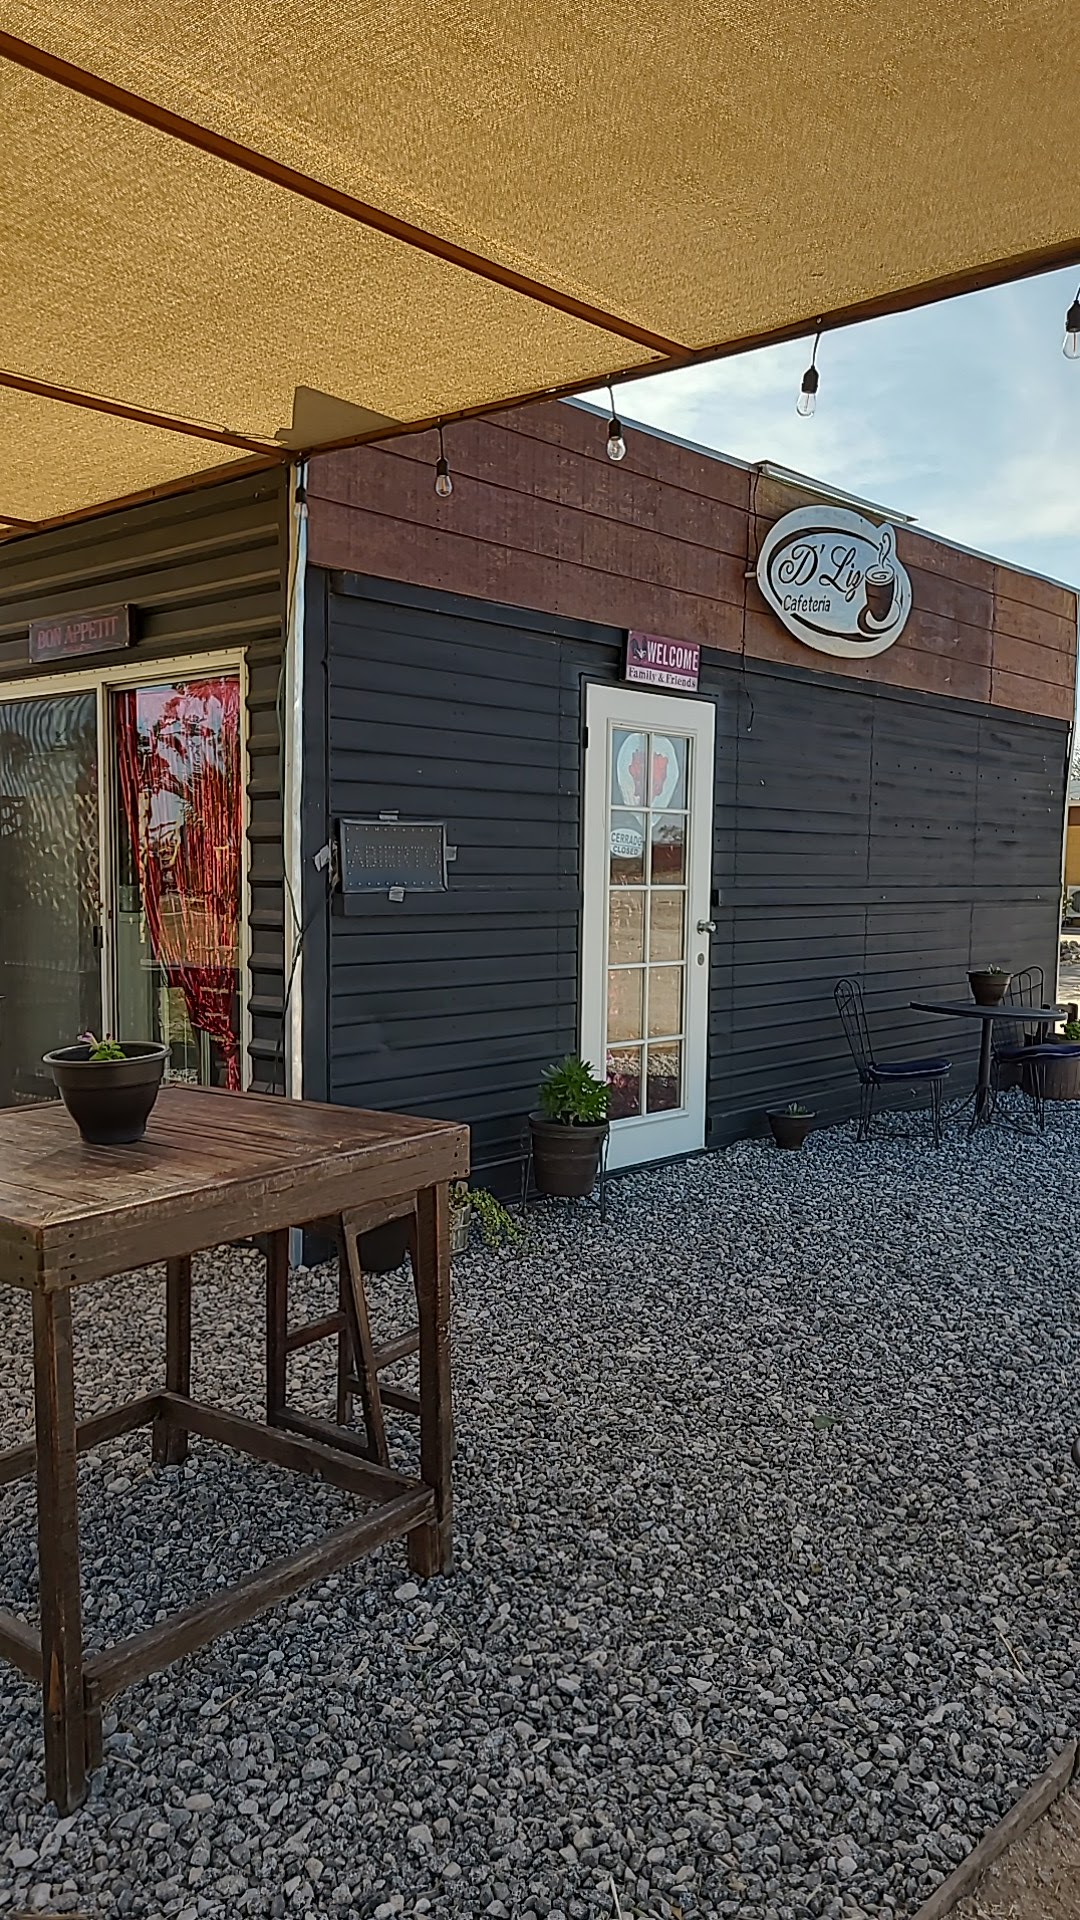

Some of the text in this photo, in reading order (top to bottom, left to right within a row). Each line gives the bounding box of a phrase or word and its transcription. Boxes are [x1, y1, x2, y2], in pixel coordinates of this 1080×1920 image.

[783, 594, 831, 613] Cafeteria
[37, 627, 62, 650] BON
[647, 641, 699, 672] WELCOME
[628, 666, 696, 689] Family & Friends
[612, 845, 639, 856] CLOSED
